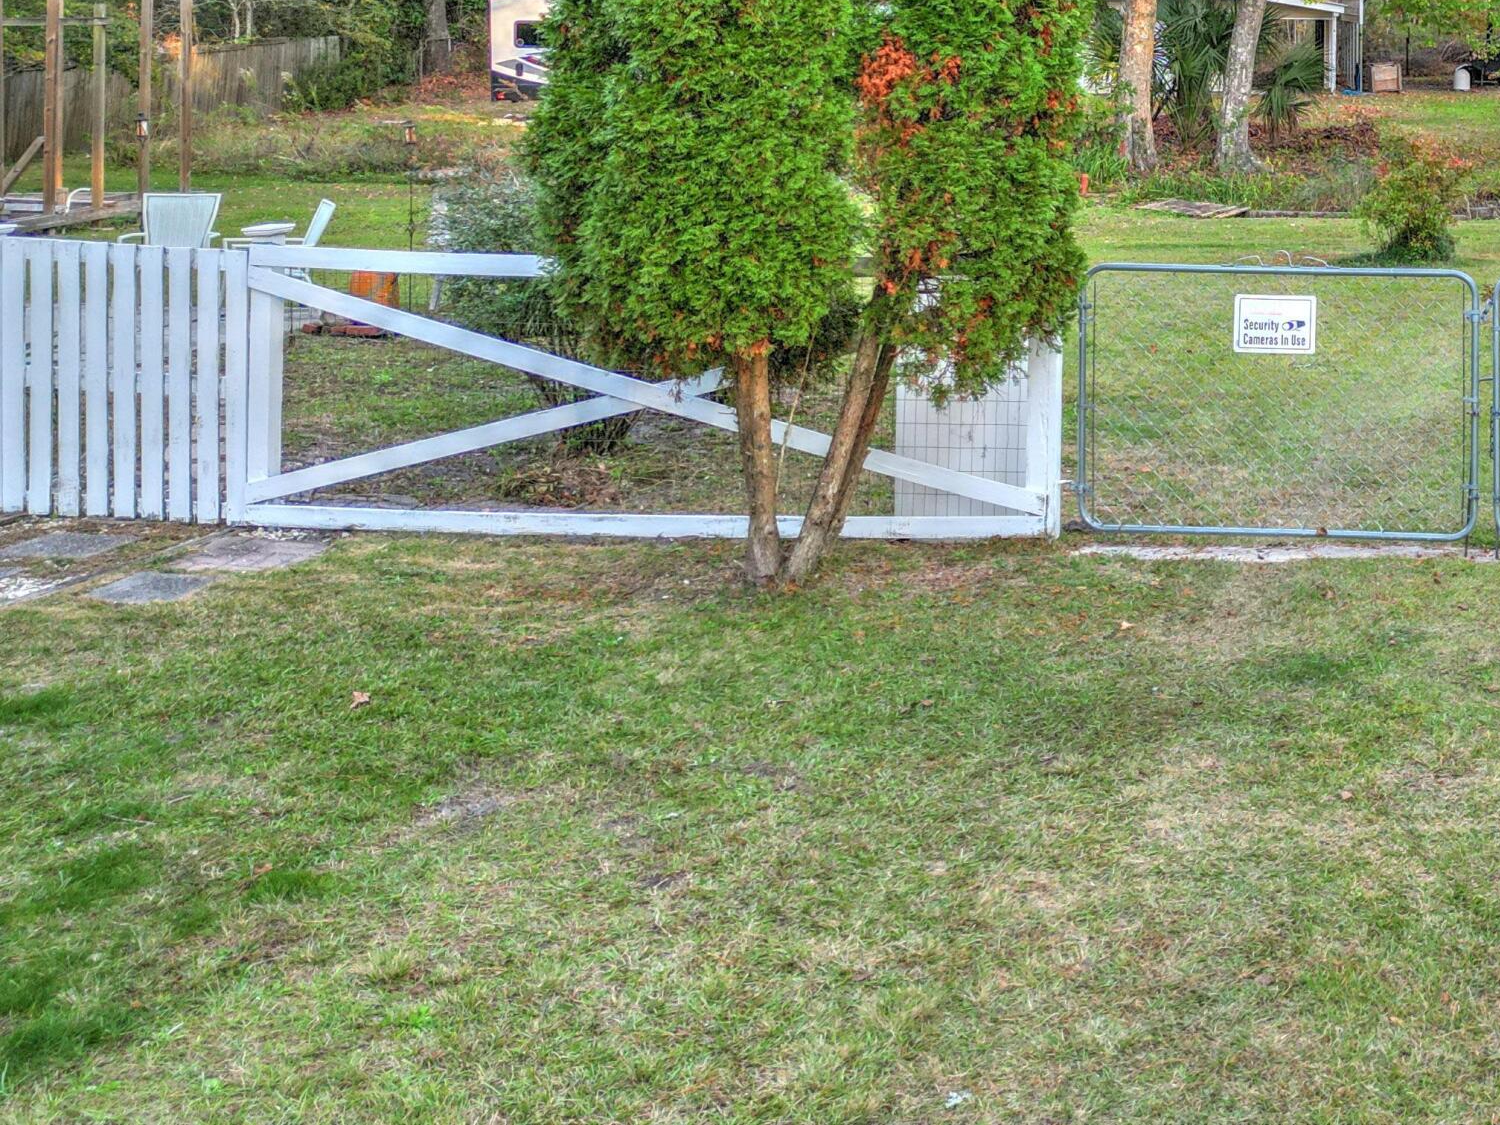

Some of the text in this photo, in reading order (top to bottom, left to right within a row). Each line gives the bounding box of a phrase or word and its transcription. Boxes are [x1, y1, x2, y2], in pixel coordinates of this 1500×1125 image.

[1243, 318, 1279, 333] Security
[1243, 333, 1306, 346] Cameras In Use
